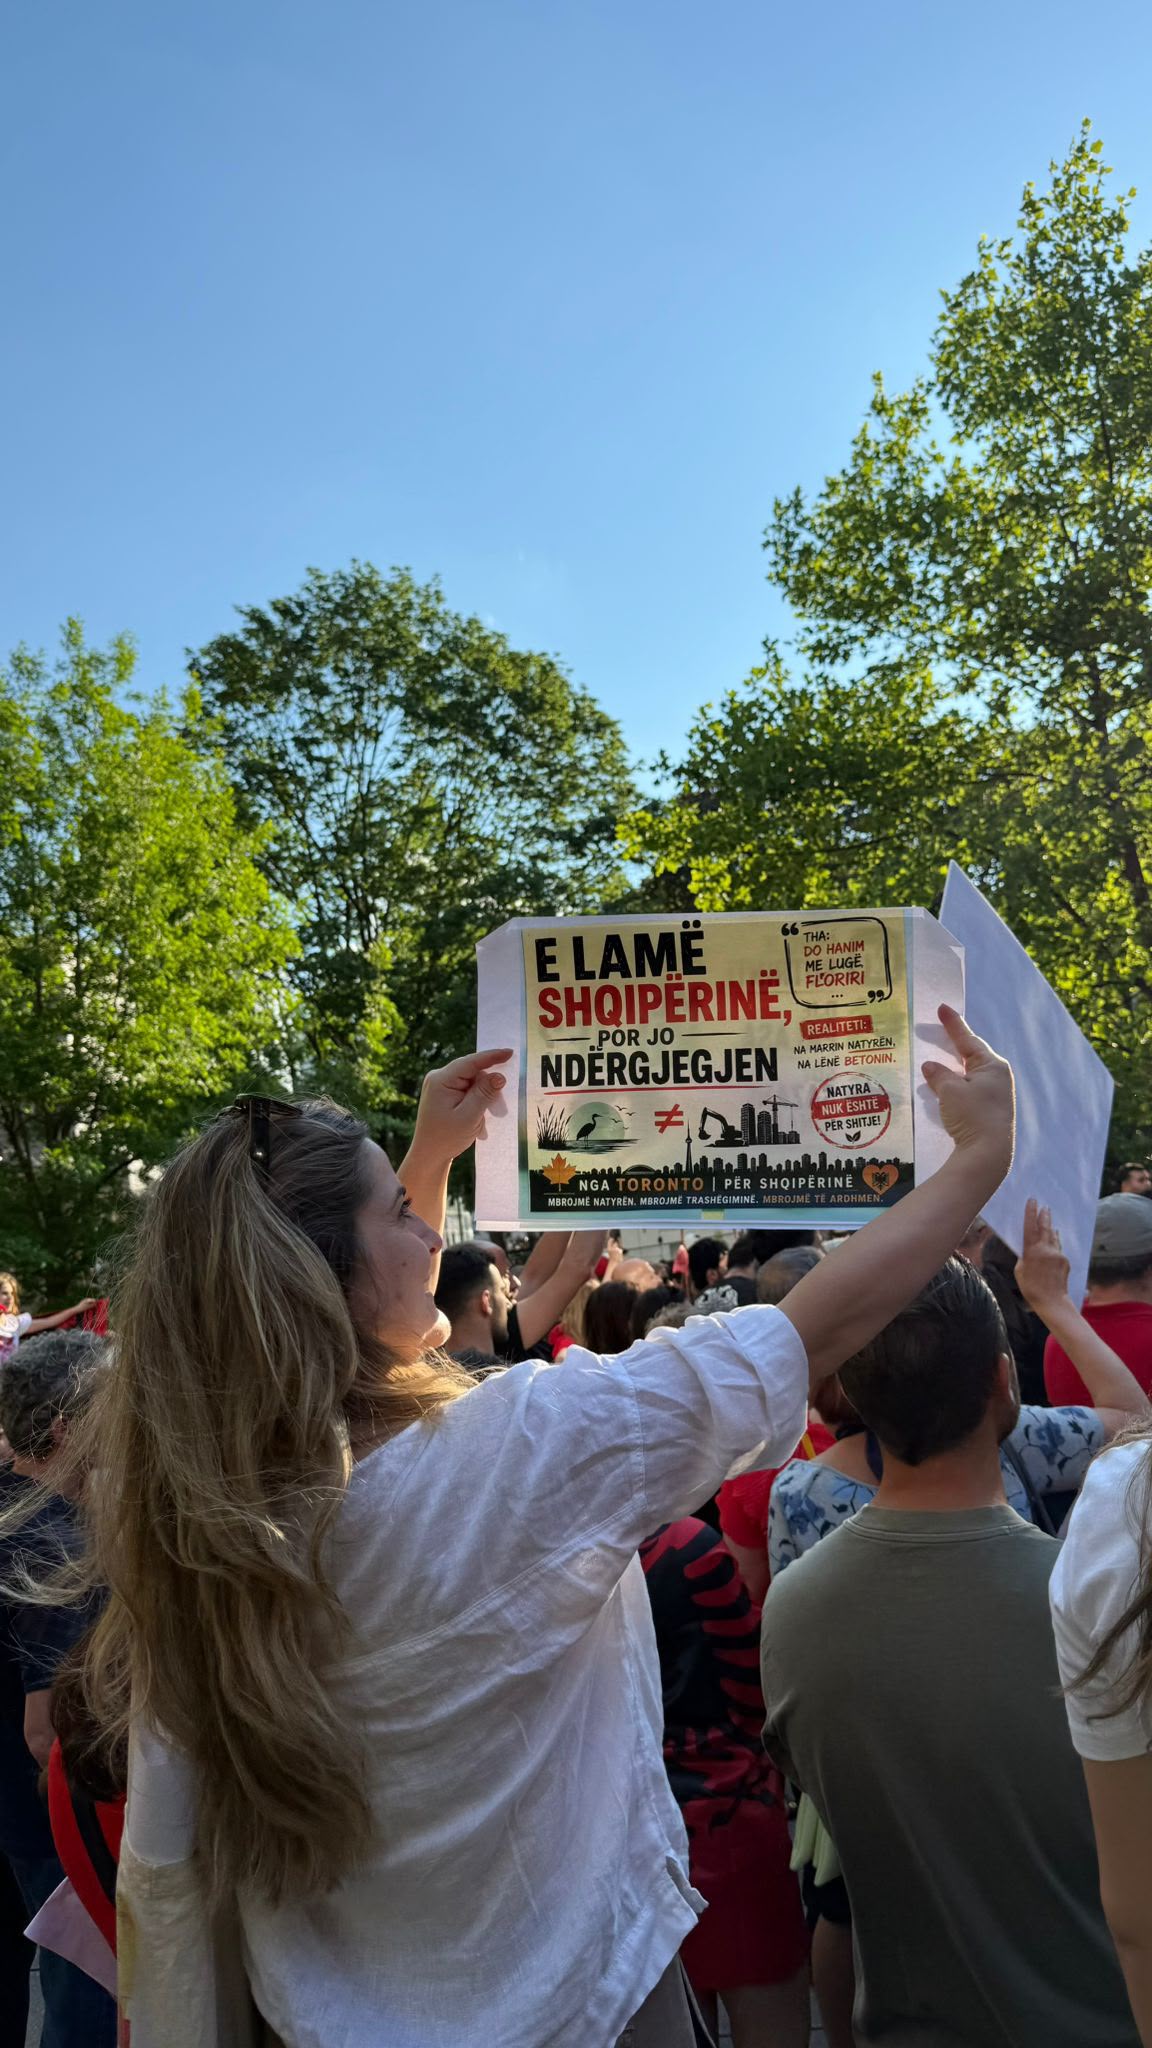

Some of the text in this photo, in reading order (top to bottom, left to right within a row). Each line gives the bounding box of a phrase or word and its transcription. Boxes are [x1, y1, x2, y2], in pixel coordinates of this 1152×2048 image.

[803, 931, 830, 943] THA:
[535, 919, 707, 982] E LAMË
[803, 940, 865, 958] DO HANIM
[805, 960, 823, 973] ME
[538, 968, 792, 1029] SHQIPËRINË,
[807, 1020, 867, 1036] REALITETI:
[598, 1027, 675, 1047] POR JO
[793, 1045, 807, 1055] NA
[809, 1042, 844, 1054] MARRIN
[540, 1045, 779, 1088] NDËRGJEGJEN
[797, 1053, 896, 1070] NA LËNË BETONIN.
[826, 1082, 871, 1098] NATYRA
[821, 1096, 879, 1116] NUK ËSHTË
[824, 1115, 881, 1132] PËR SHITJE!
[579, 1174, 854, 1192] NGA TORONTO PËR SHQIPËRINË
[548, 1192, 884, 1207] MBROJMË NATYRËN. MBROJMË TRASHËGIMINË. MBROJMË TË ARDHMEN.
